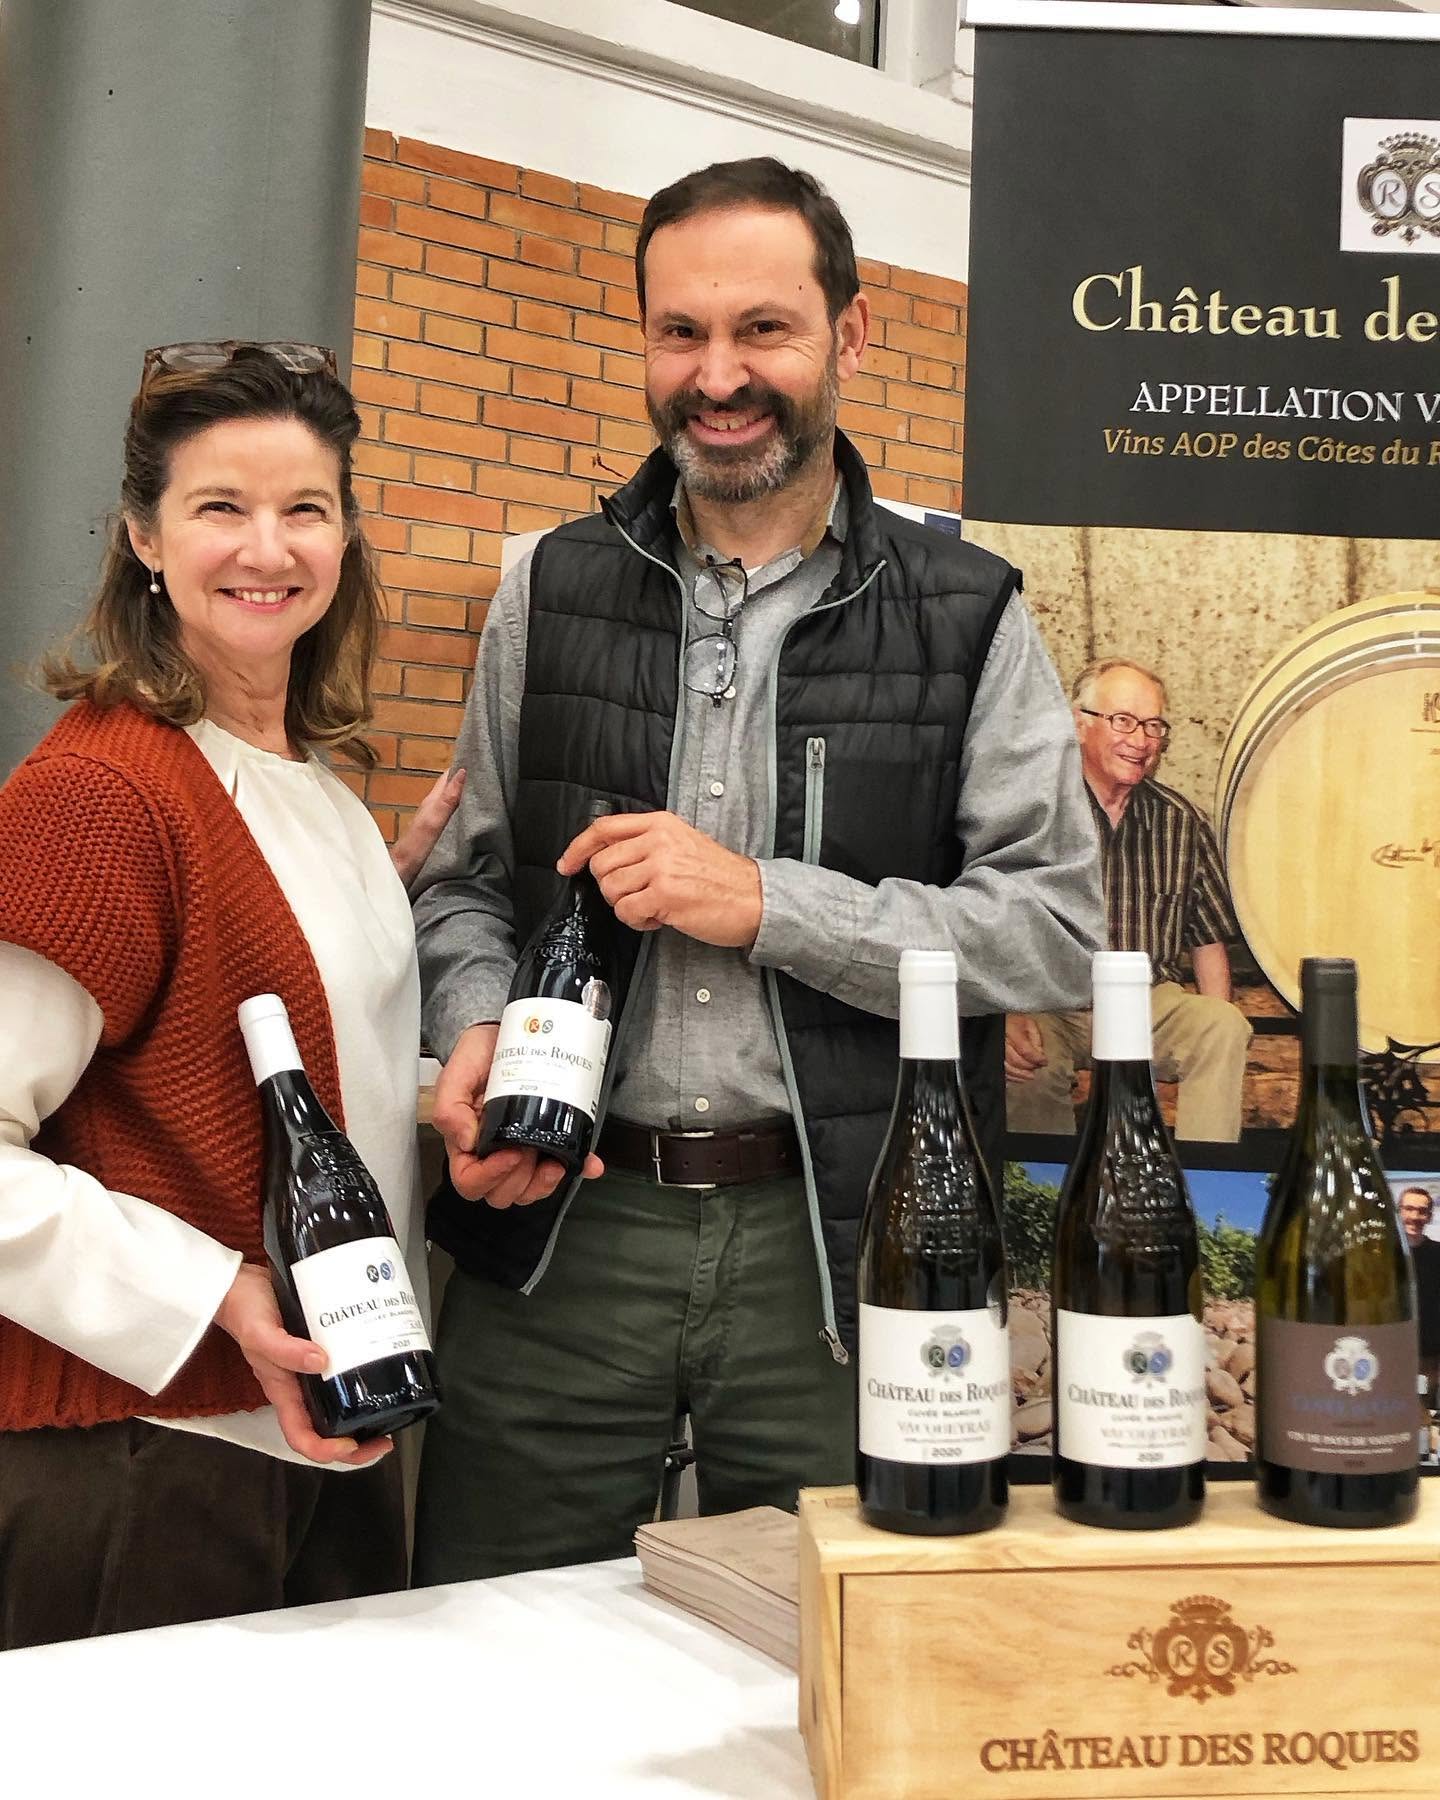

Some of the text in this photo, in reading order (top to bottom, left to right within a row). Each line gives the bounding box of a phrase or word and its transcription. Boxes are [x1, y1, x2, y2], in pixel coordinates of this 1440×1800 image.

[1071, 265, 1439, 342] Château de
[1129, 382, 1440, 423] APPELLATION V
[1102, 428, 1164, 456] Vins
[1171, 432, 1238, 459] AOP
[1243, 432, 1291, 461] des
[1298, 434, 1374, 466] Côtes
[1382, 439, 1419, 467] du
[551, 1046, 593, 1072] ROQUES
[319, 1299, 381, 1328] CHÂTEAU
[867, 1378, 936, 1402] CHÂTEAU
[939, 1391, 962, 1402] DES
[979, 1728, 1421, 1774] CHÂTEAU DES ROQUES
